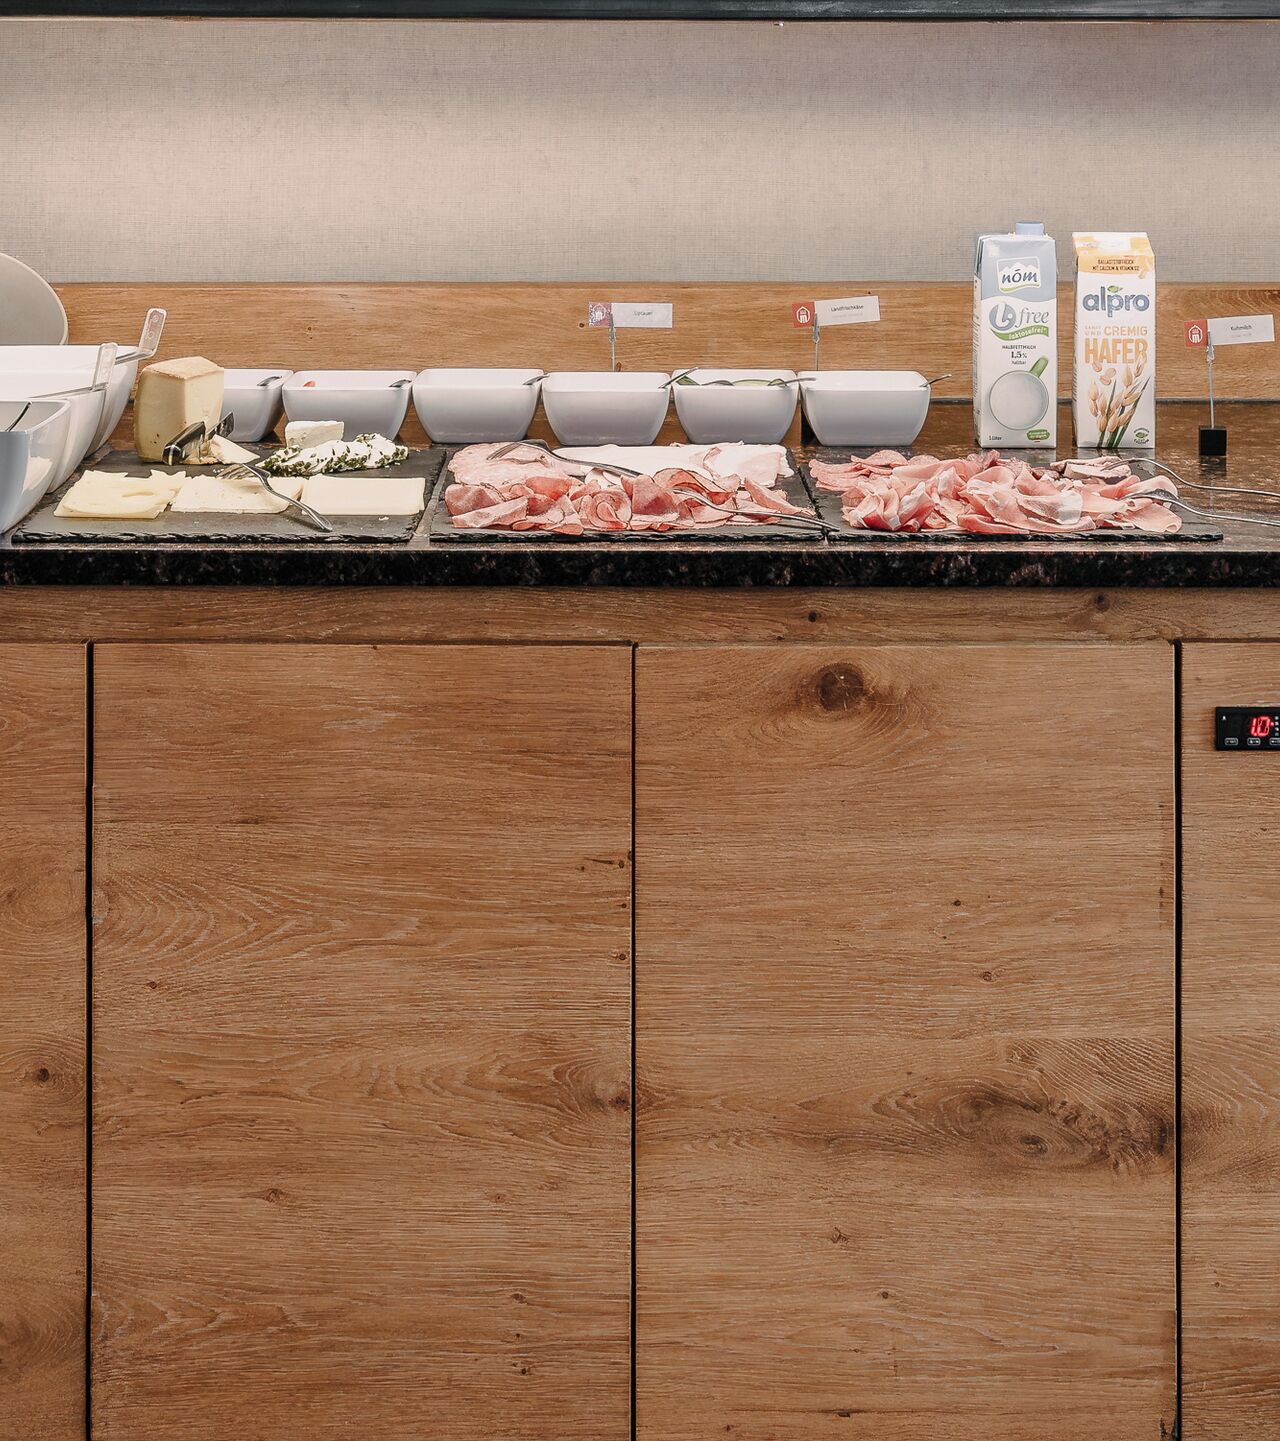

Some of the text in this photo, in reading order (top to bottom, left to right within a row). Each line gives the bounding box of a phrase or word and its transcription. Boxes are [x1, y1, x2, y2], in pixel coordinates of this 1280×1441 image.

[1082, 286, 1150, 317] alpro
[1015, 307, 1050, 328] free
[1104, 325, 1148, 336] CREMIG
[1084, 337, 1148, 364] HAFER
